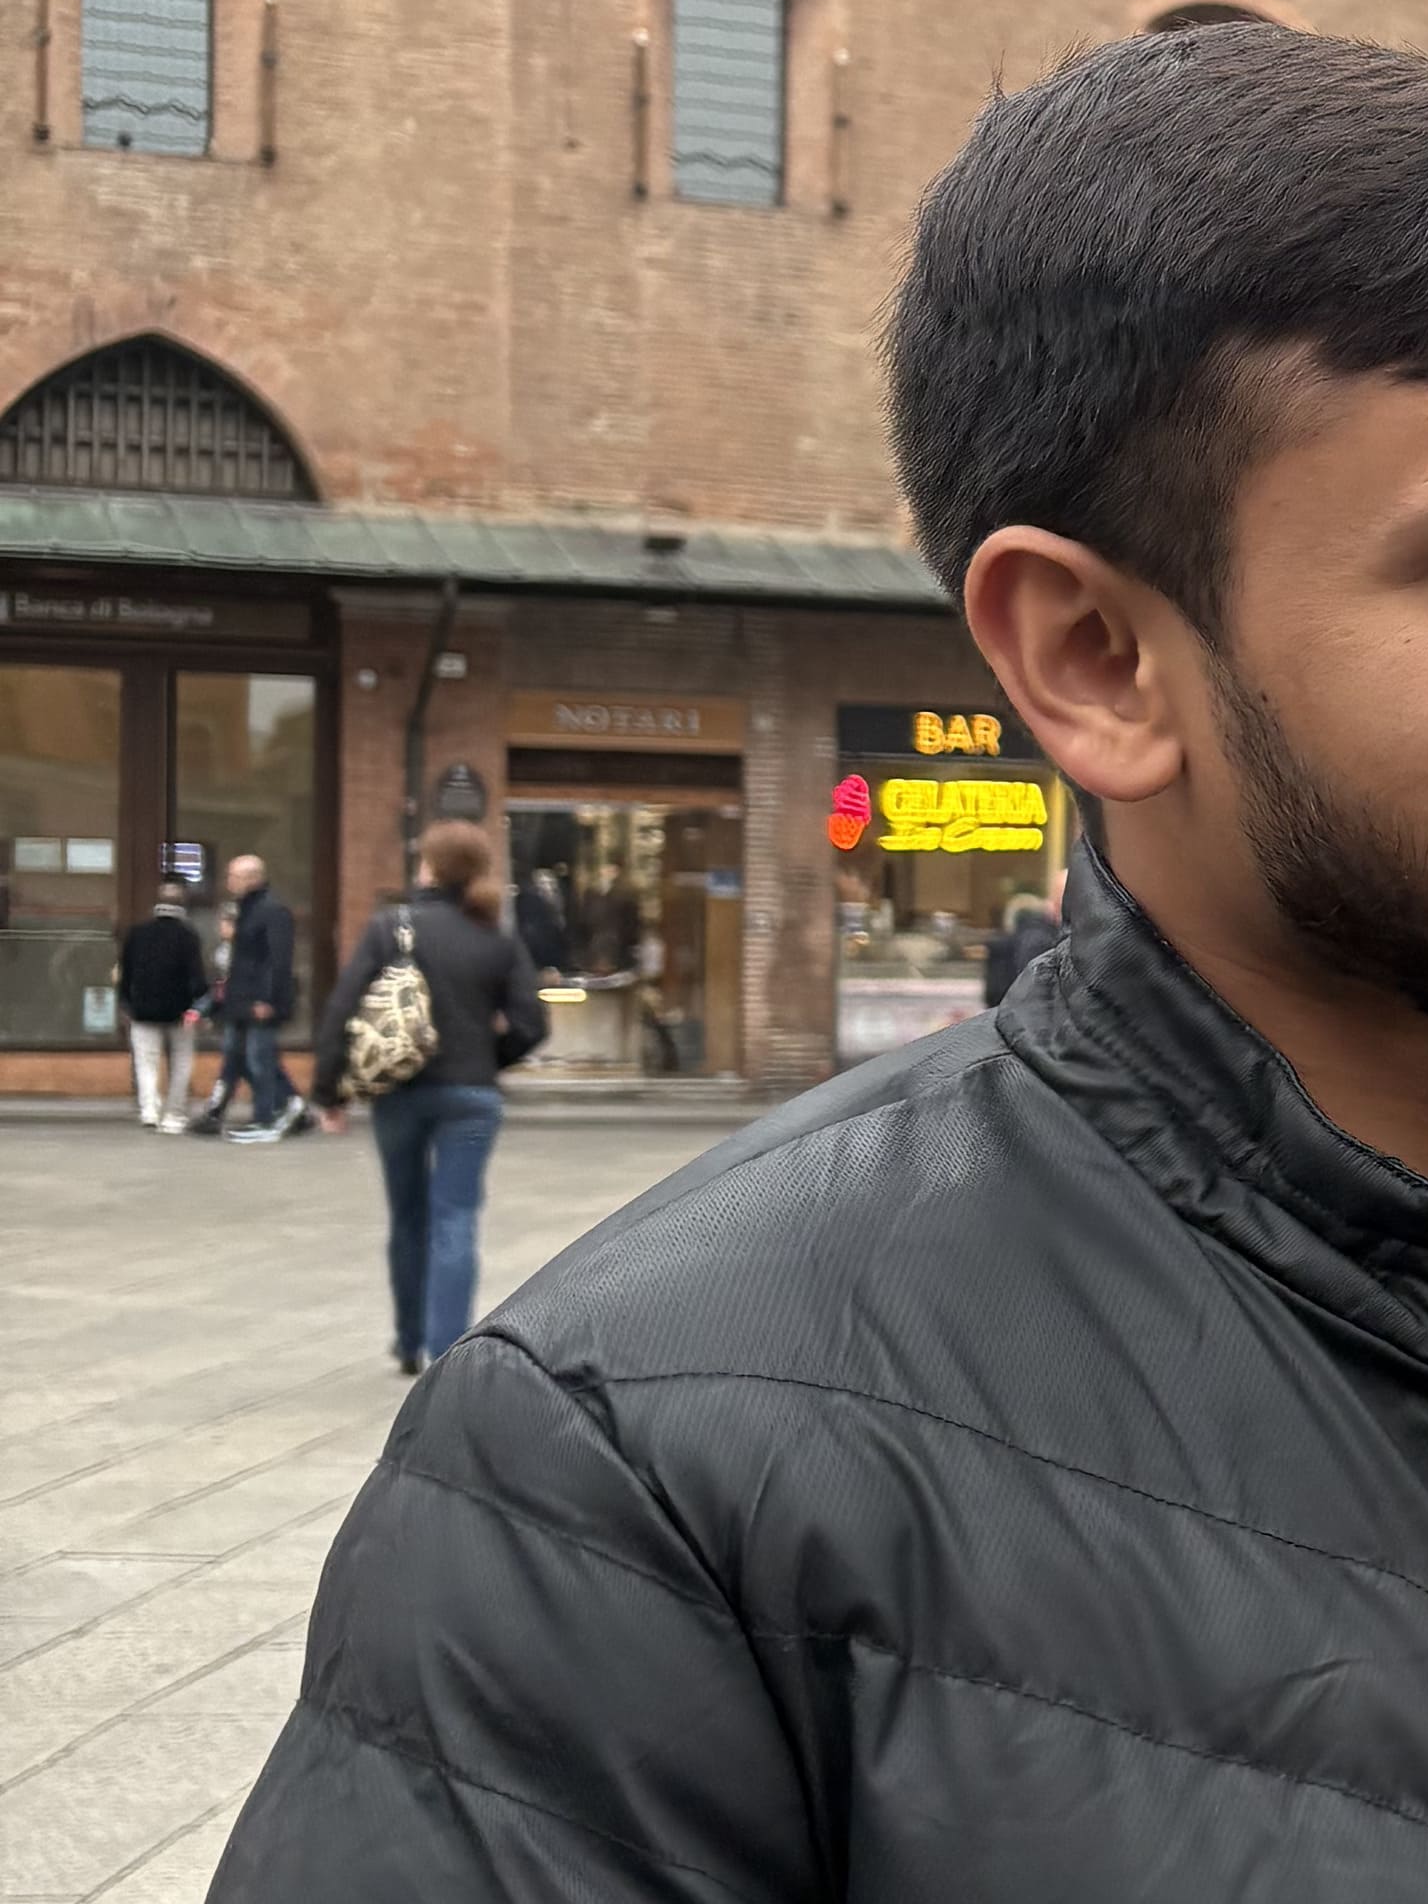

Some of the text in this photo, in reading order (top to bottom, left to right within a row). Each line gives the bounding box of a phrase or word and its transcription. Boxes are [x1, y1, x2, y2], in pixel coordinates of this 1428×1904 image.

[555, 703, 699, 737] NOTARI
[914, 711, 1001, 756] BAR
[883, 779, 1047, 824] GELATERIA
